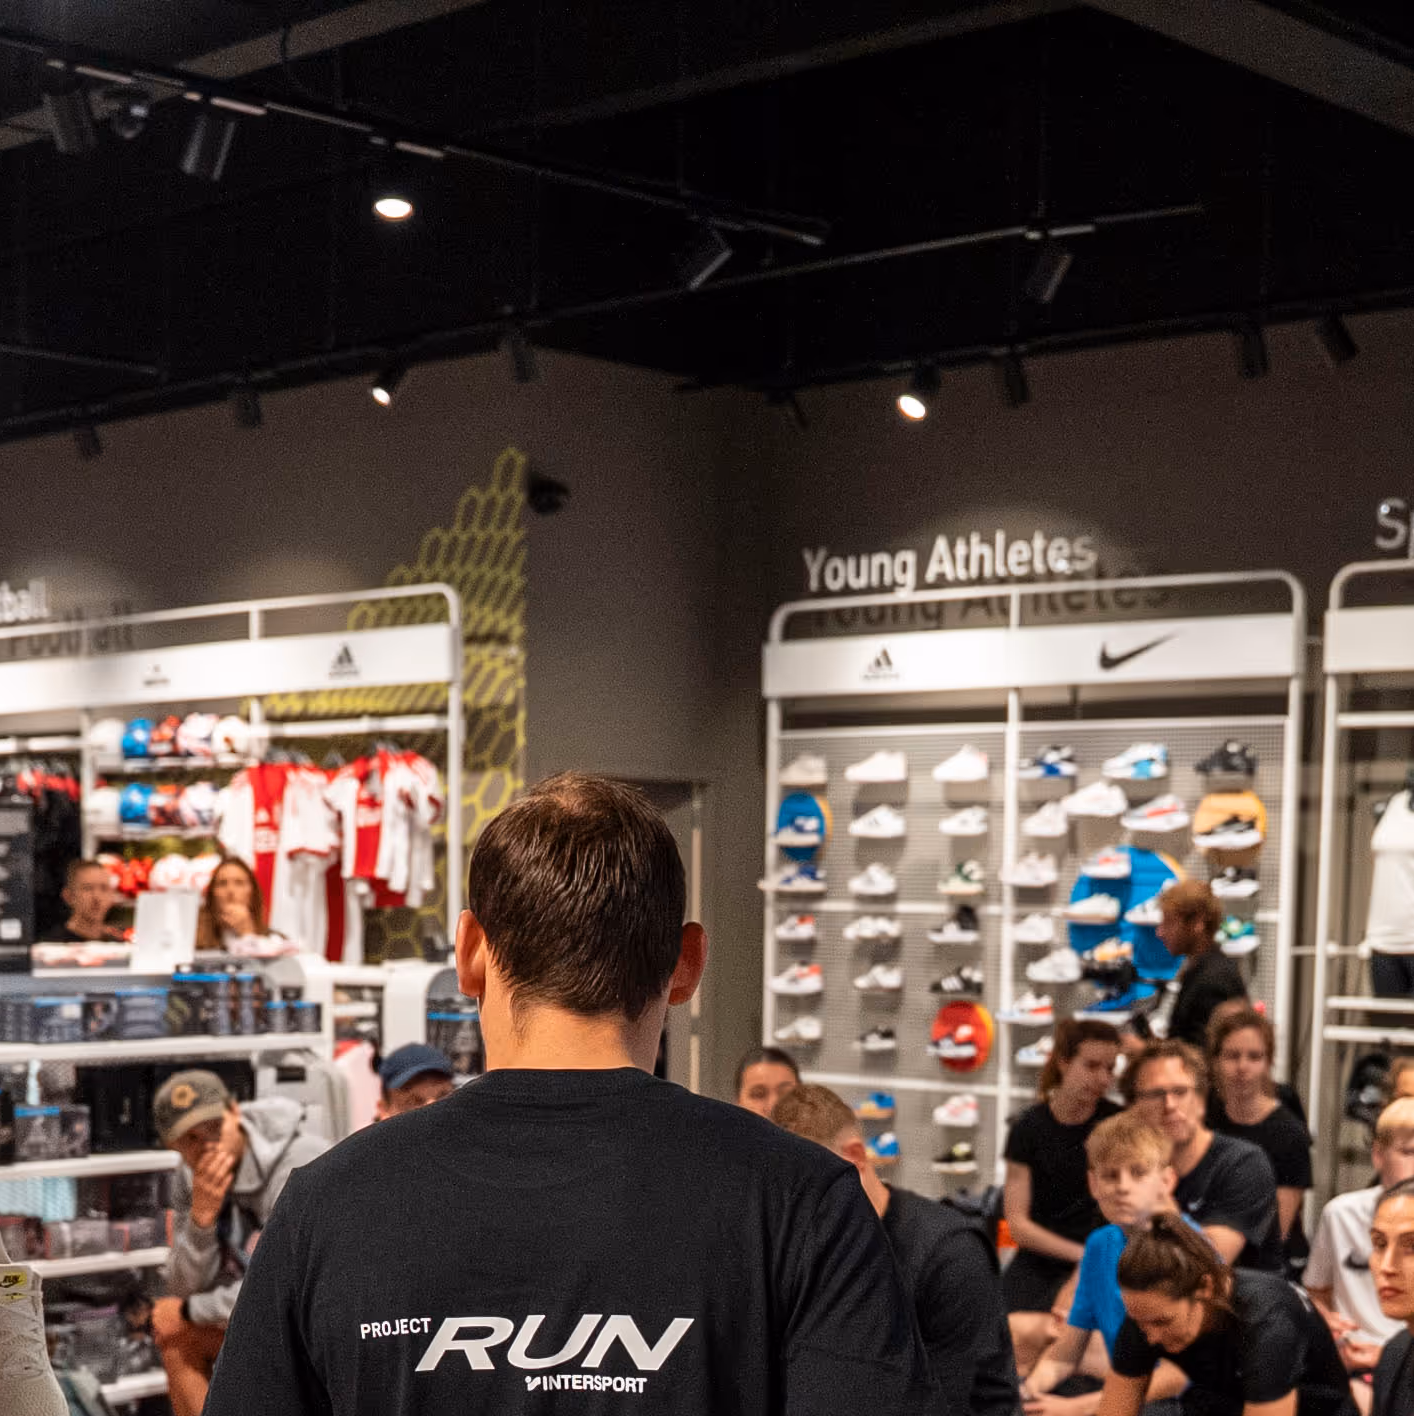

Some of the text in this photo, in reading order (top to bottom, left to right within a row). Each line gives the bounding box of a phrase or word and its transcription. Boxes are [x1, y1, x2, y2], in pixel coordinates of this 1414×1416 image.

[801, 528, 1099, 598] Young Athletes
[360, 1313, 695, 1372] PROJECT RUN
[542, 1374, 648, 1394] INTERSPORT
